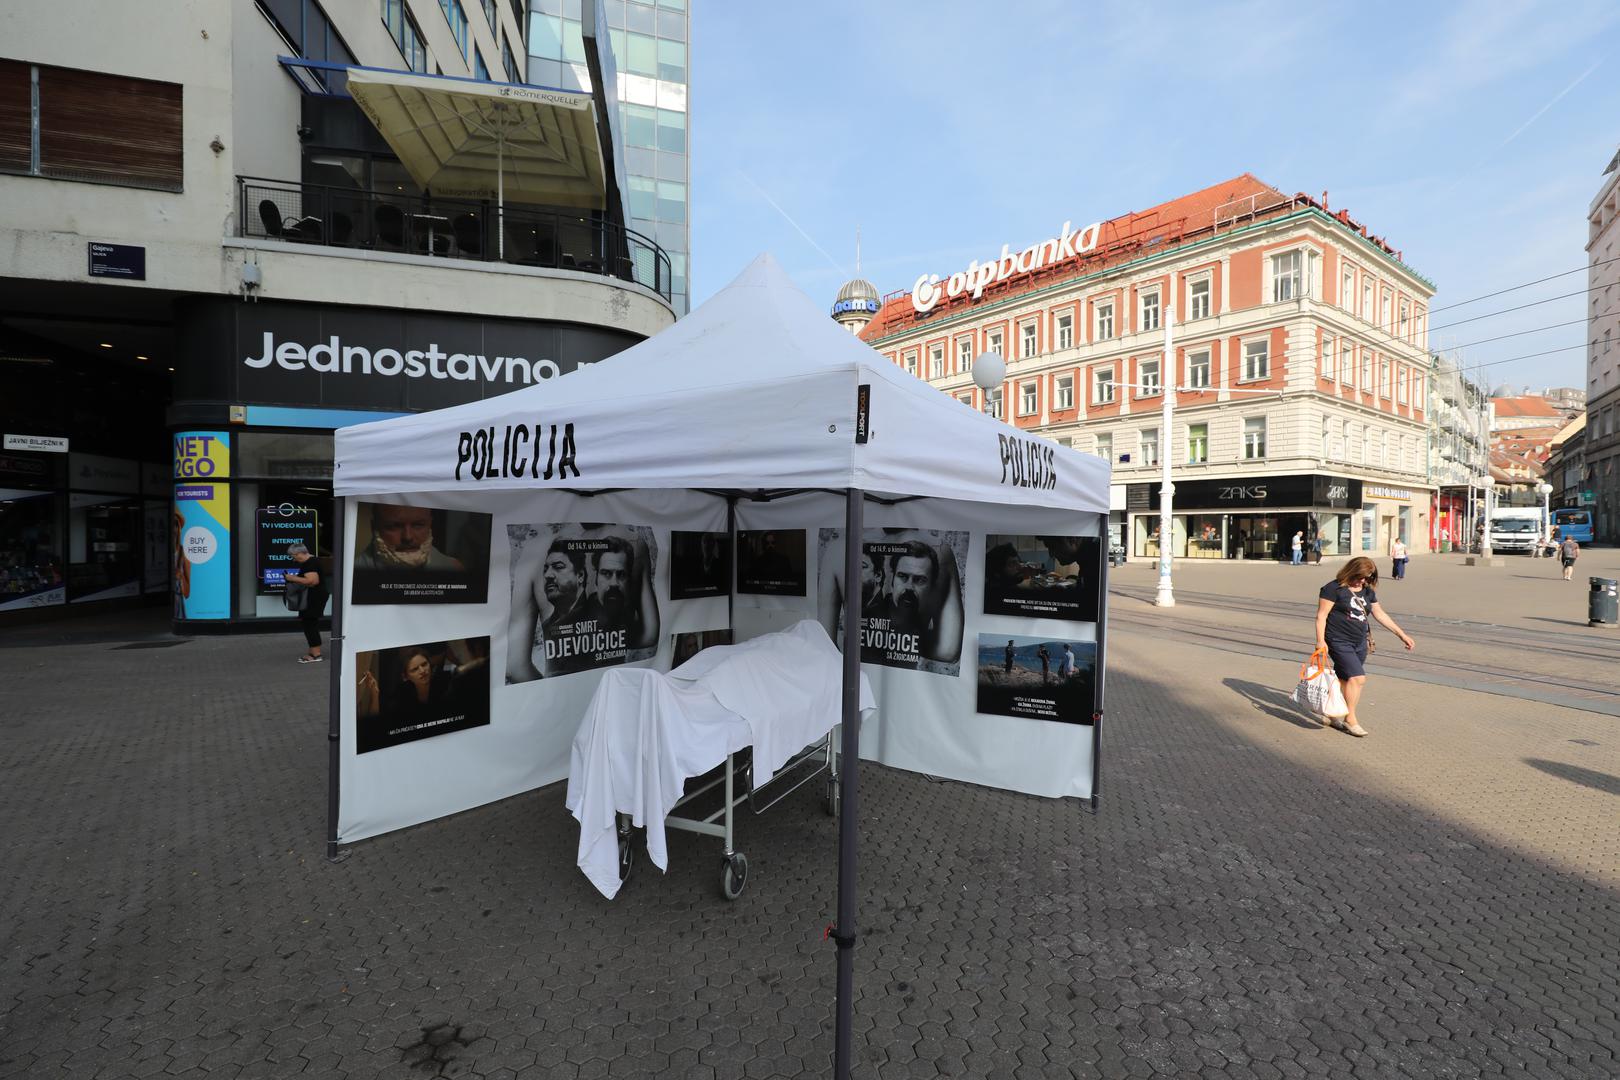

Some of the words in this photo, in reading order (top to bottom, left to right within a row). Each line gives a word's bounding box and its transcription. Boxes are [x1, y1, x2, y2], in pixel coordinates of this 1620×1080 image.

[244, 331, 561, 385] Jednostavno
[858, 390, 867, 437] TOOLPORT
[455, 422, 580, 481] POLICIJA
[997, 432, 1057, 490] POLICIJA
[1218, 486, 1268, 500] ZAKS
[266, 502, 308, 516] EON
[575, 620, 598, 634] SMRT
[870, 618, 891, 630] SMRT
[545, 630, 626, 660] DJEVOJČICE
[860, 630, 920, 653] EVOJČICE
[595, 653, 602, 661] SA
